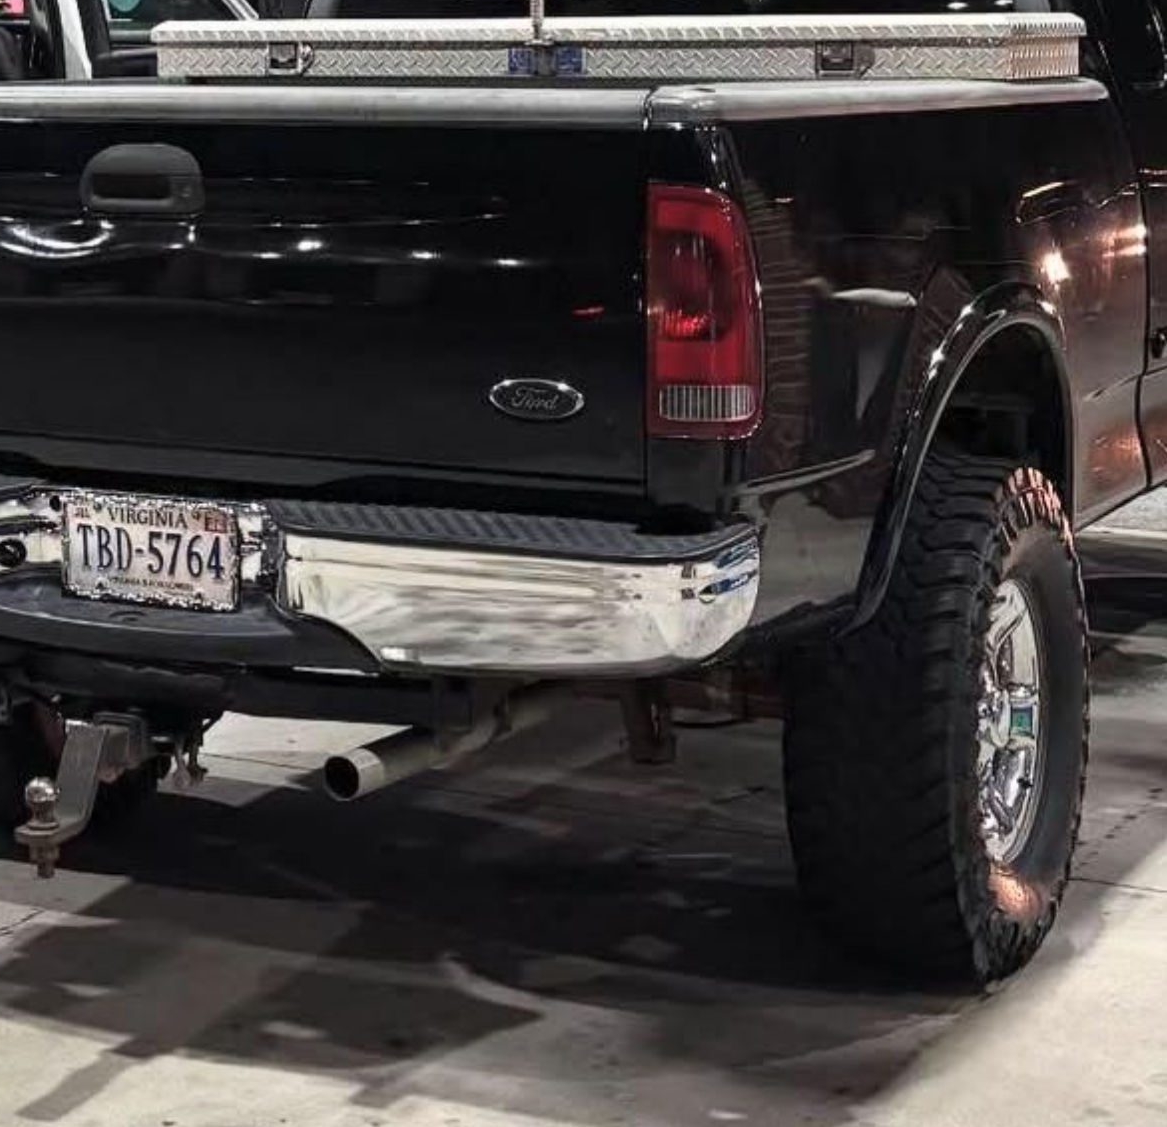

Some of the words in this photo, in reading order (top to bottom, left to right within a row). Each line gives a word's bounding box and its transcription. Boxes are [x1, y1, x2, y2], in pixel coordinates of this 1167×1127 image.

[511, 386, 559, 410] Ford
[108, 506, 187, 529] VIRGINIA
[77, 523, 225, 582] TBD-5764
